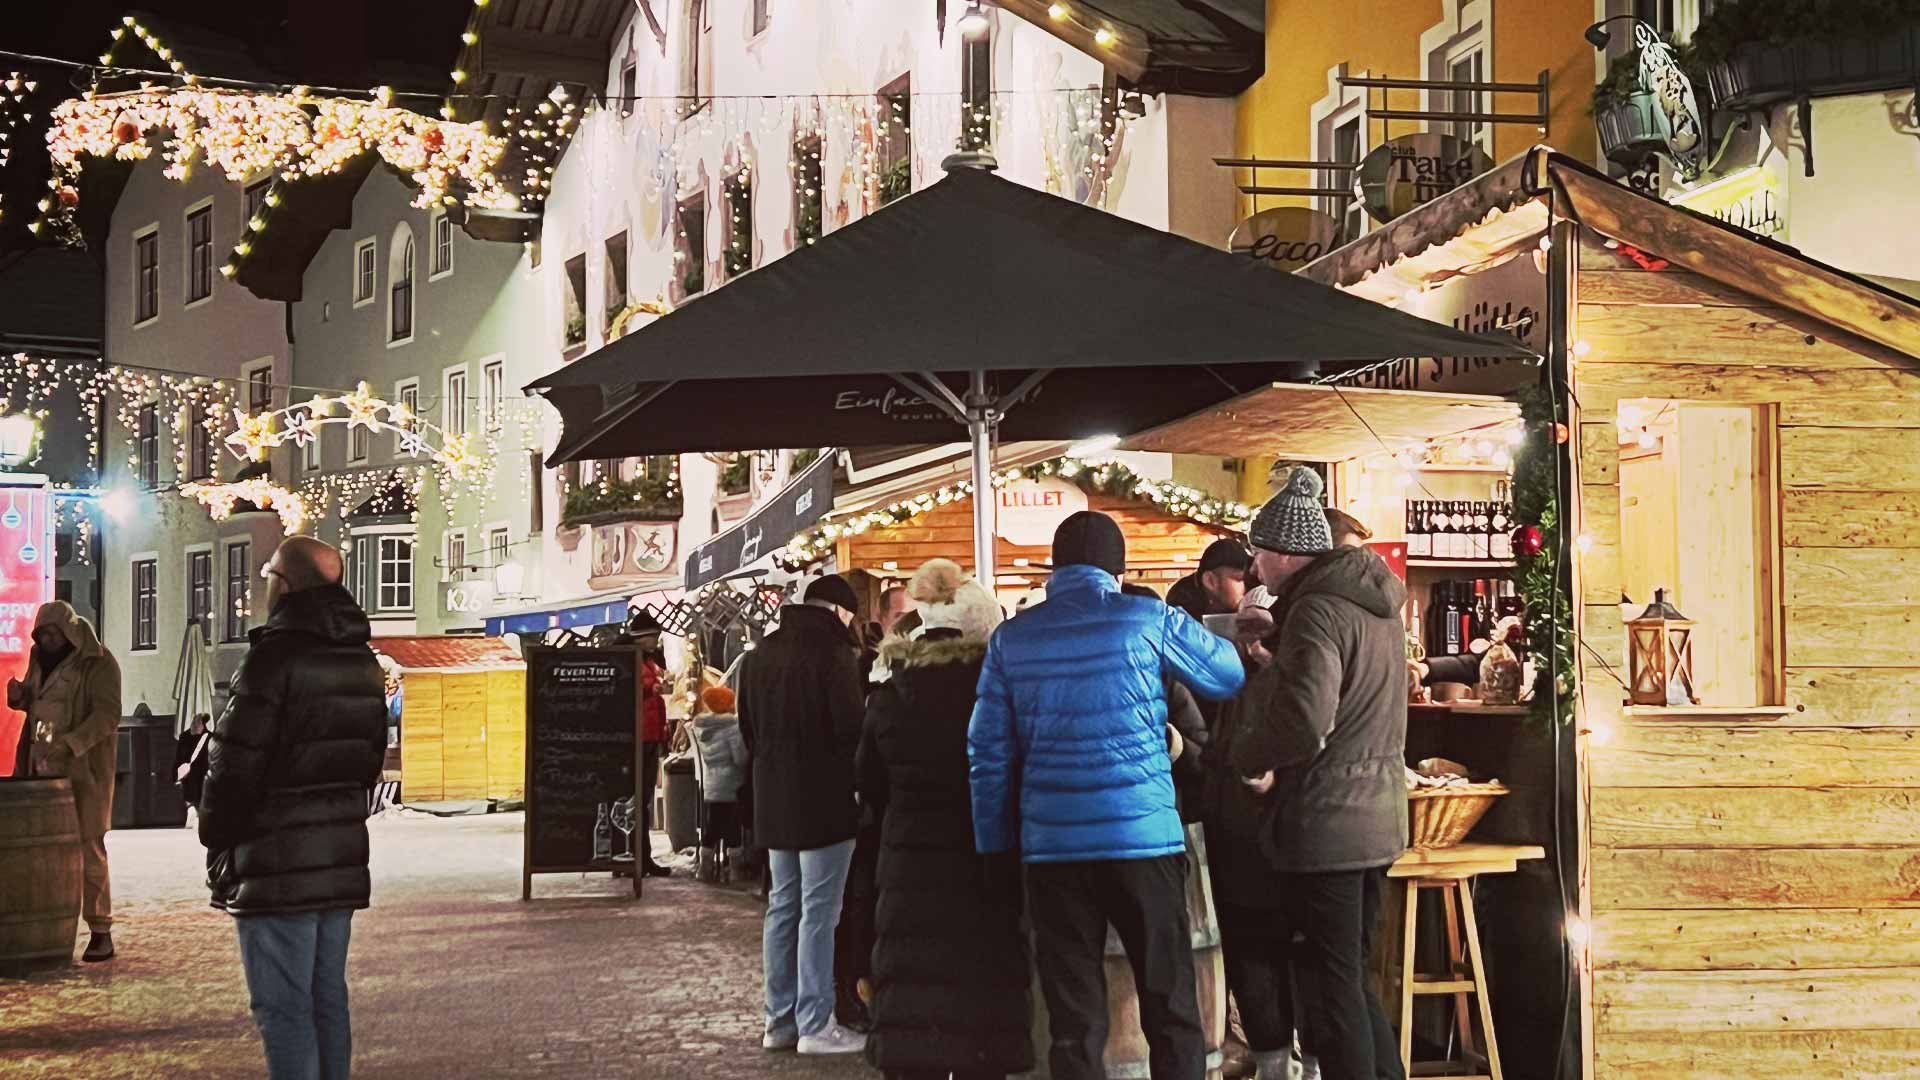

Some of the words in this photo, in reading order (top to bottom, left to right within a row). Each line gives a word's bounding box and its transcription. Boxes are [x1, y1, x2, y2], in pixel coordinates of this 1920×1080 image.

[1391, 145, 1416, 155] club
[1390, 155, 1473, 182] Take
[836, 386, 935, 415] Einfac
[1002, 490, 1064, 507] LILLET
[447, 588, 482, 613] K26
